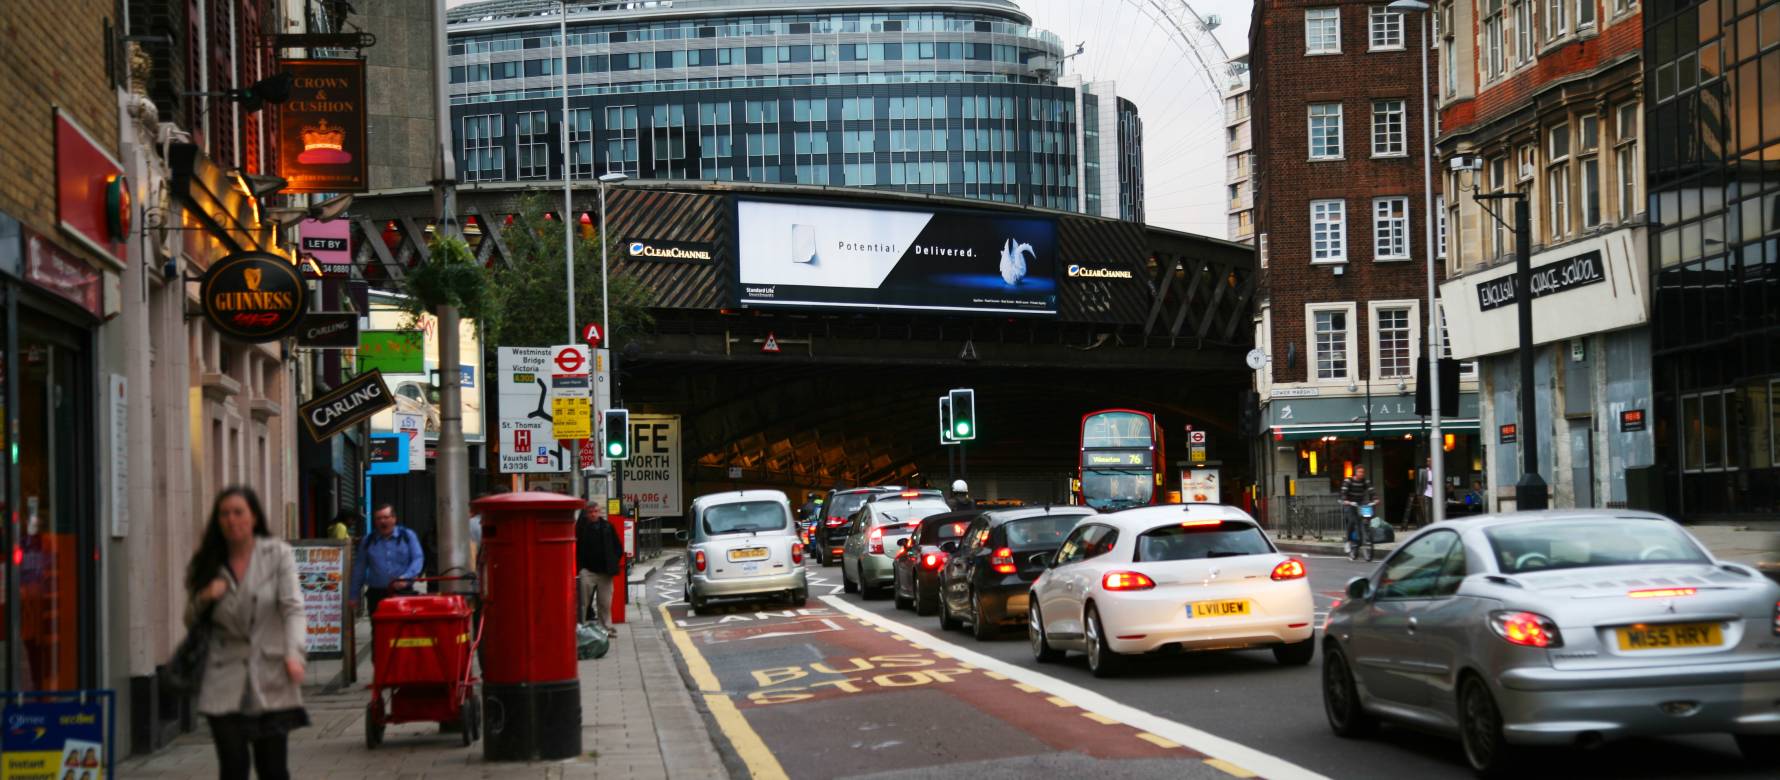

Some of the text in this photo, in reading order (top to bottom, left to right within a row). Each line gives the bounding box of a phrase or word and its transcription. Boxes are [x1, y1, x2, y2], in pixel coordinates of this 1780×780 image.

[294, 79, 349, 88] CROWN
[315, 89, 327, 99] &
[289, 101, 354, 111] CUSHION
[308, 240, 326, 248] LET
[838, 242, 977, 258] Potential. Delivered.
[1561, 258, 1600, 286] SCHOOL
[215, 291, 293, 311] GUINNESS
[307, 321, 349, 339] CARLING
[587, 325, 600, 340] A
[511, 348, 552, 356] Westminste
[511, 364, 540, 372] Victoria
[311, 382, 382, 427] CARLING
[1362, 403, 1416, 414] WAL
[501, 421, 512, 429] St.
[517, 431, 529, 445] H
[624, 456, 670, 468] WORTH
[1128, 454, 1141, 464] 76
[1221, 602, 1244, 614] UEW
[675, 608, 833, 628] LANE
[1674, 626, 1712, 646] HRY
[751, 653, 937, 688] BUS
[747, 667, 977, 705] STOP
